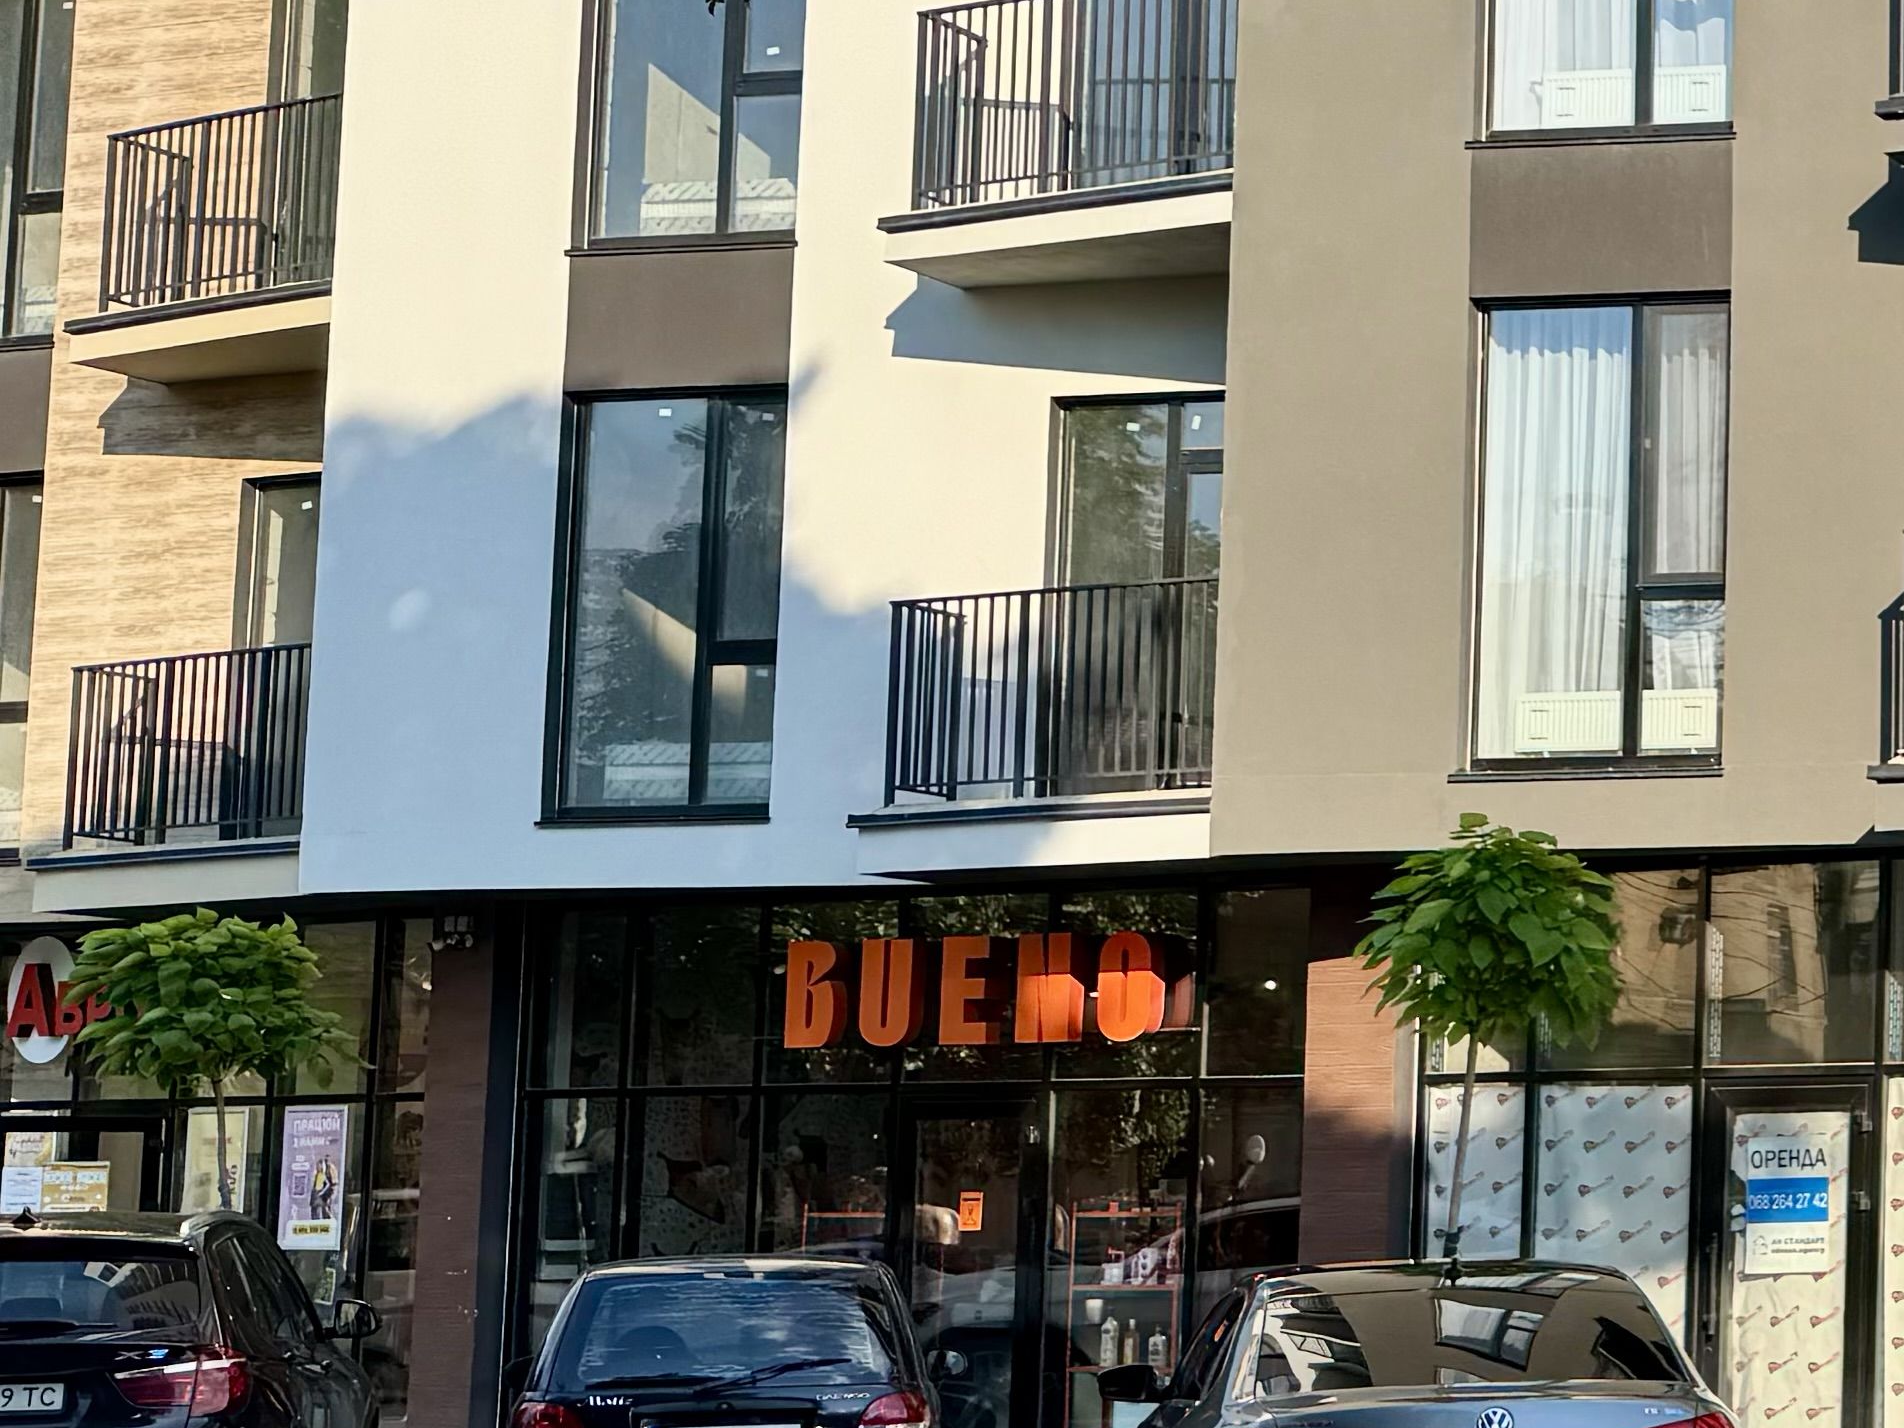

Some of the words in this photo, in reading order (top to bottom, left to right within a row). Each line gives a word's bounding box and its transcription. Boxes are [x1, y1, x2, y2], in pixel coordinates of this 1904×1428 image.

[784, 932, 1160, 1048] BUENO
[1751, 1148, 1827, 1170] ОРЕНДА
[1772, 1194, 1793, 1209] 264
[1796, 1193, 1809, 1209] 27
[1812, 1193, 1828, 1208] 42
[23, 1387, 56, 1408] TC
